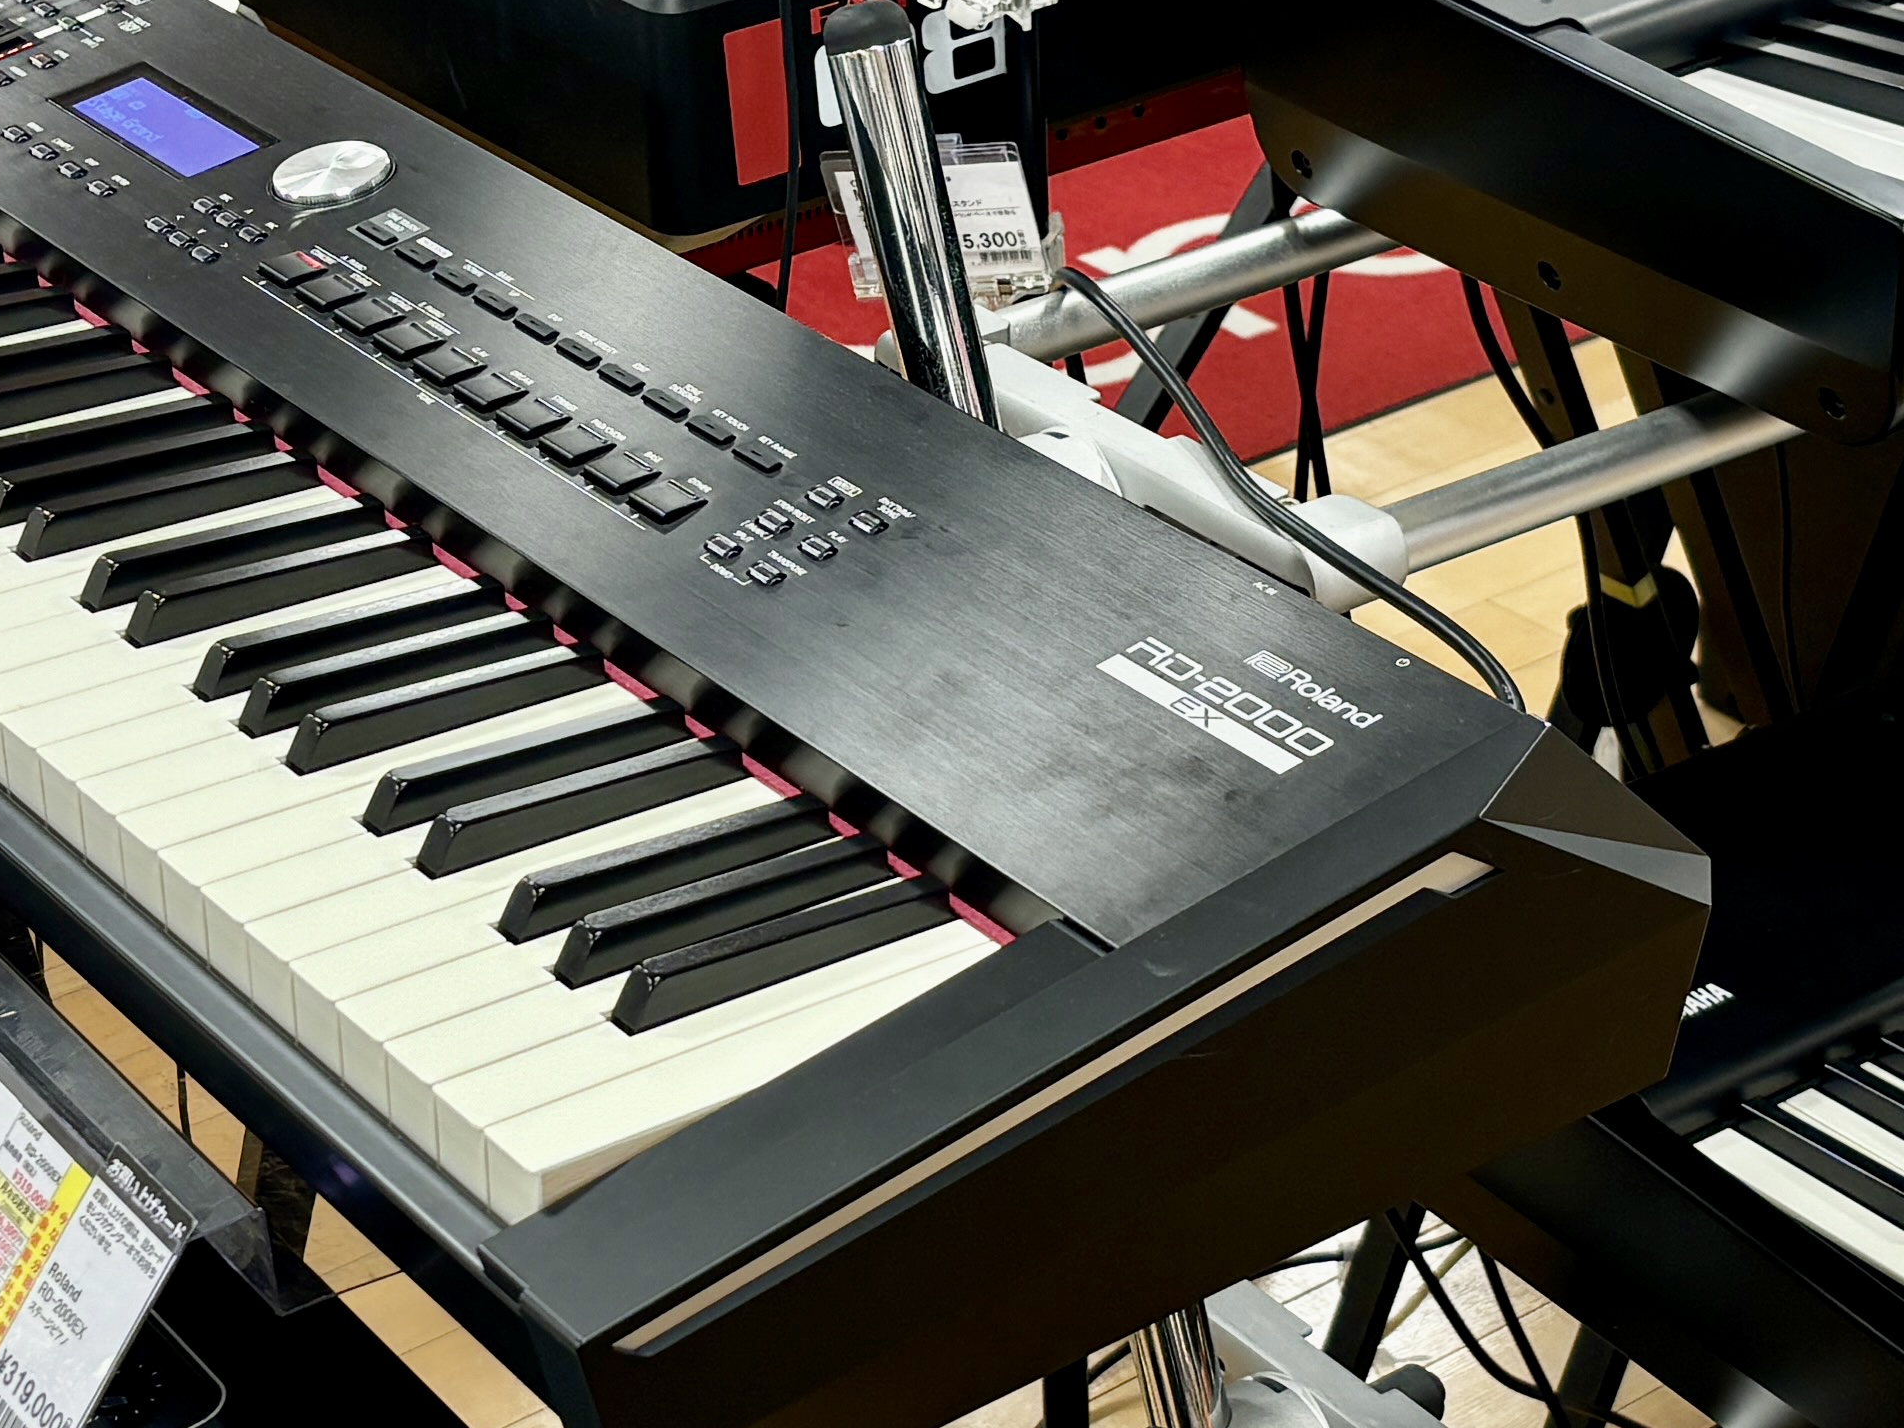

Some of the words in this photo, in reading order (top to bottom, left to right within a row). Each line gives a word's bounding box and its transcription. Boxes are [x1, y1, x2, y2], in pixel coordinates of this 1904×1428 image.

[825, 530, 850, 545] PLAY
[1126, 635, 1335, 757] RD-2000
[1168, 696, 1224, 729] EX
[1278, 668, 1384, 730] Roland
[103, 1155, 188, 1245] お買い上げカード
[36, 1279, 88, 1340] RD-2000EX
[47, 1260, 83, 1303] Roland
